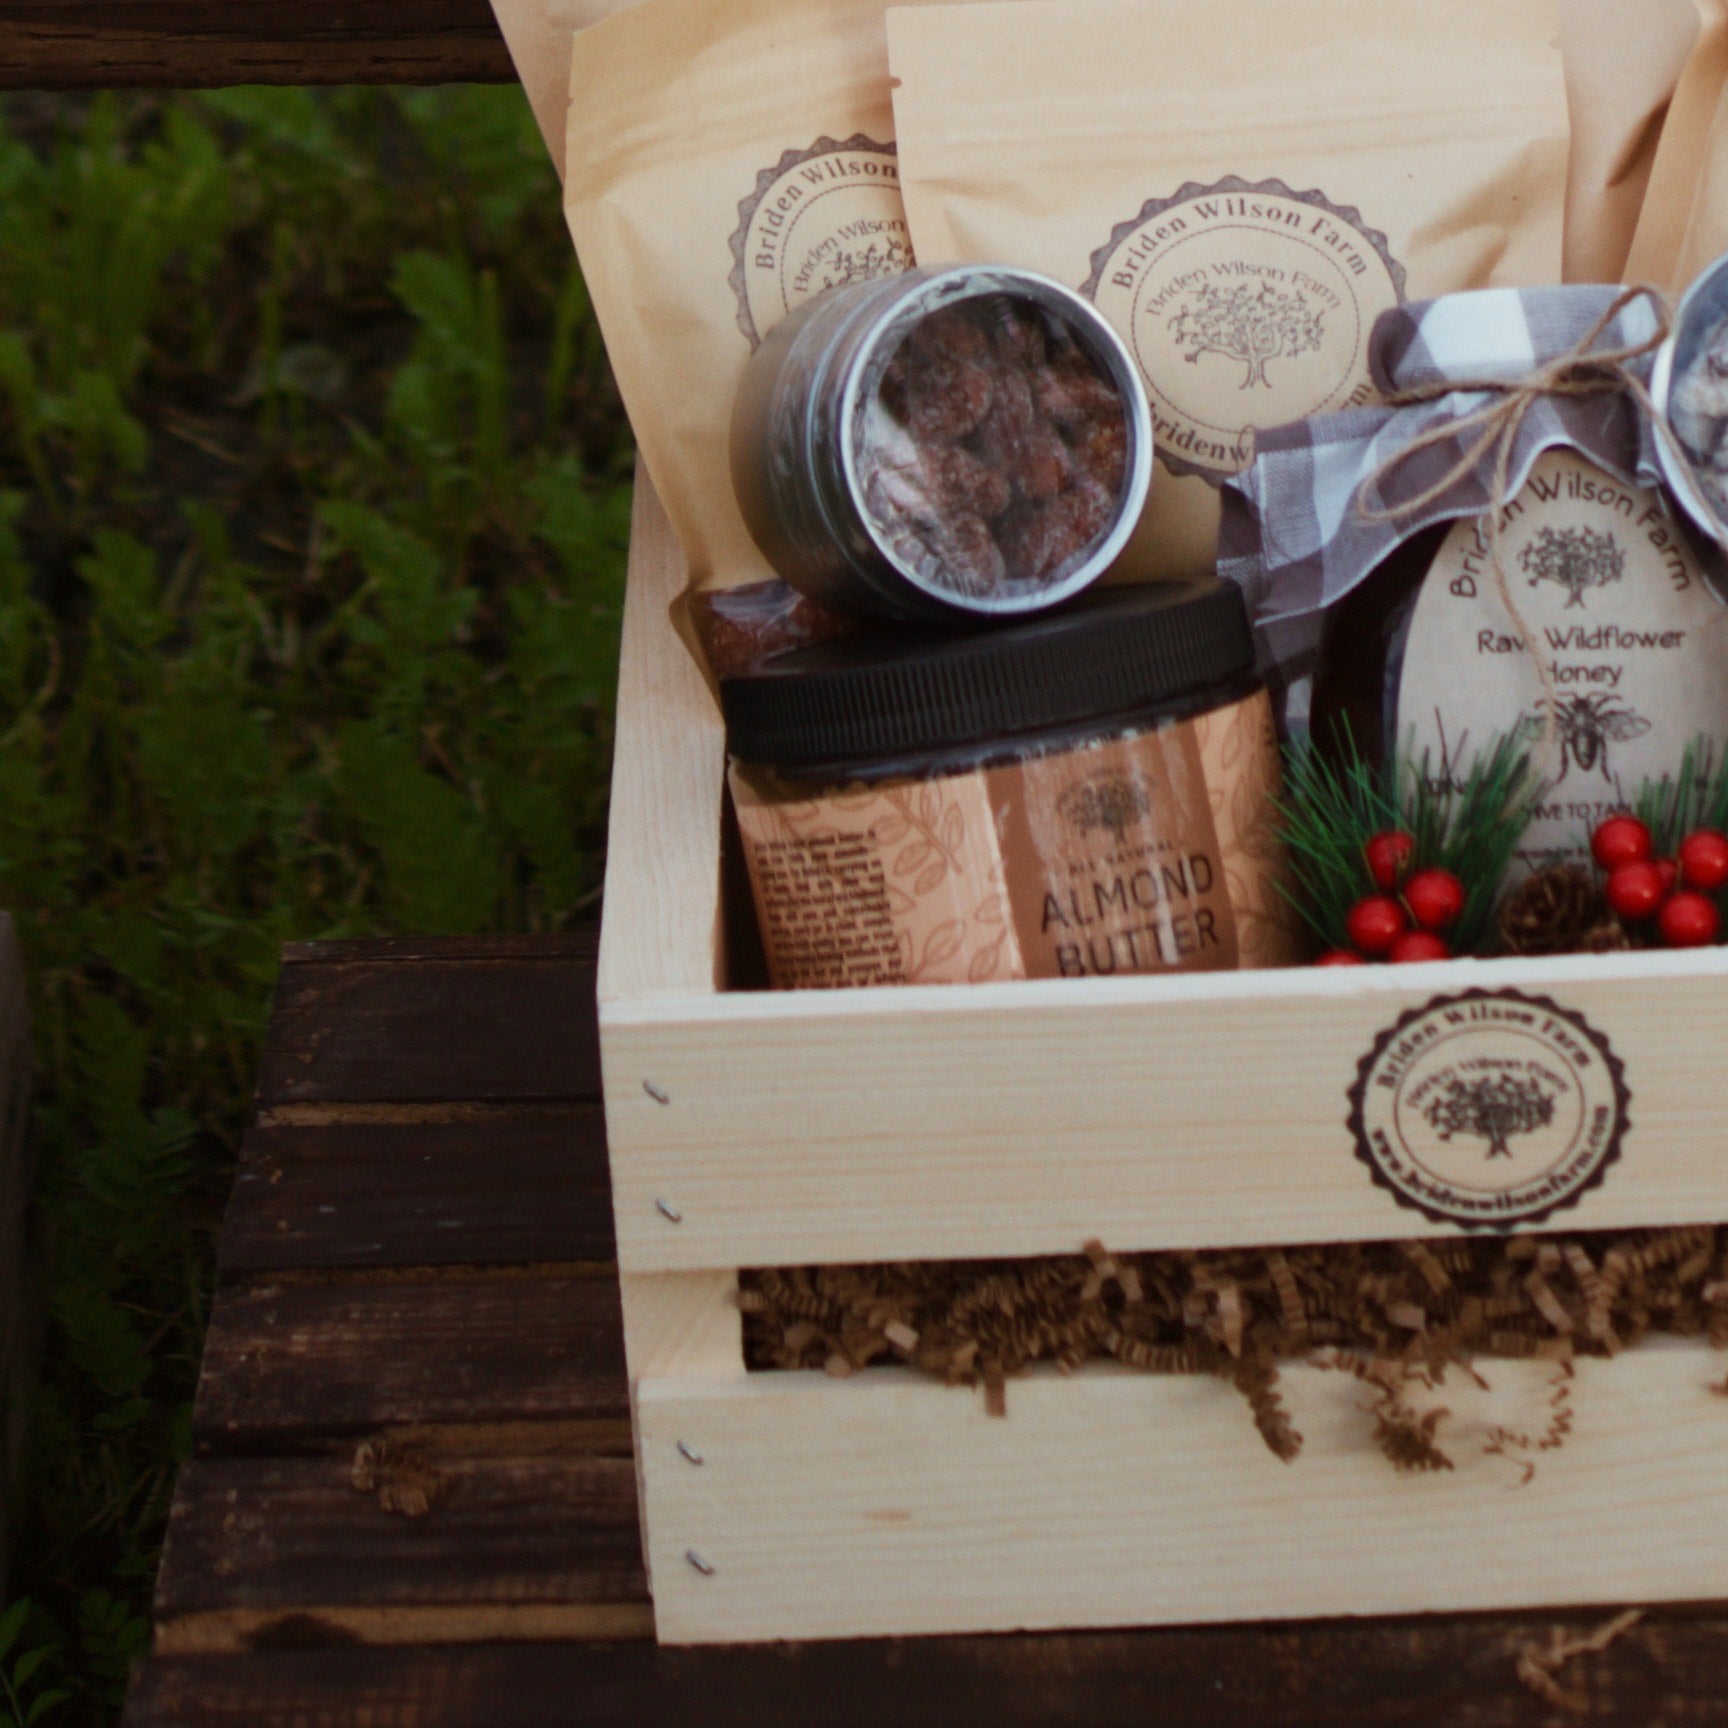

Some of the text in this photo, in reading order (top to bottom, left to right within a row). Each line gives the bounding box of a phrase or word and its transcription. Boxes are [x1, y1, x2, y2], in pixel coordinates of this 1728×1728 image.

[754, 157, 898, 271] Briden Wilson
[1110, 197, 1369, 291] Briden Wilson Farm
[793, 218, 906, 294] Briden Wilson
[1144, 259, 1343, 318] Briden Wilson Farm
[1526, 471, 1635, 518] Wilson
[1636, 500, 1691, 593] Farm
[1543, 624, 1686, 651] Wildflower
[1041, 853, 1214, 935] ALMOND
[1055, 905, 1220, 978] BUTTER
[1376, 1002, 1591, 1089] Briden Wilson Farm
